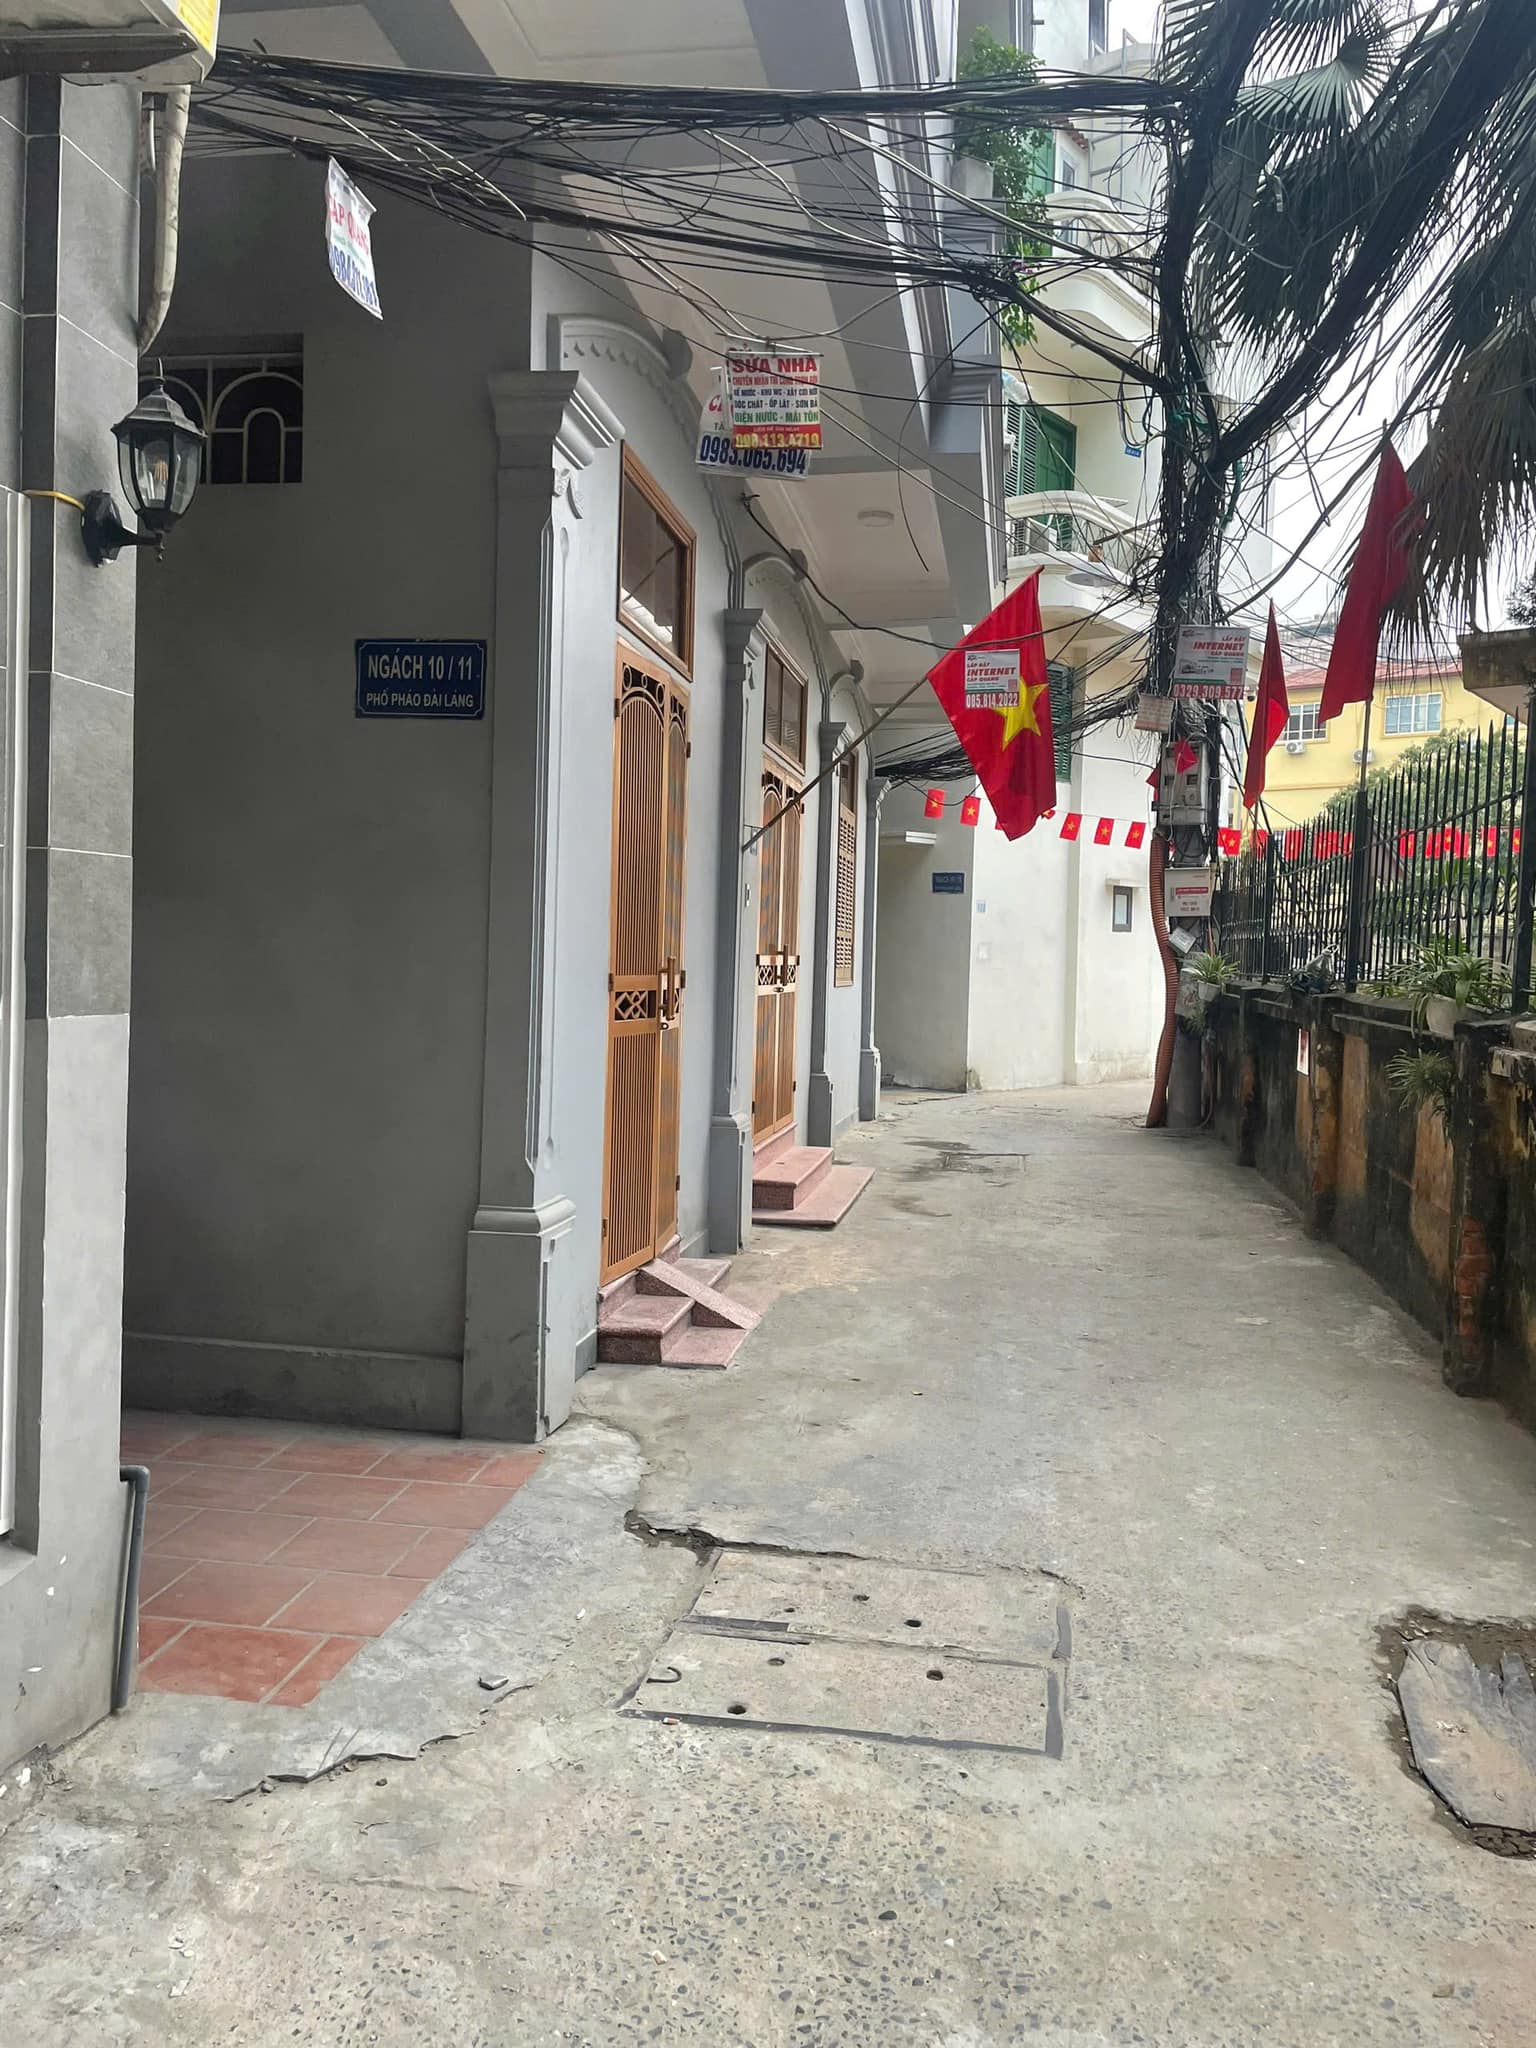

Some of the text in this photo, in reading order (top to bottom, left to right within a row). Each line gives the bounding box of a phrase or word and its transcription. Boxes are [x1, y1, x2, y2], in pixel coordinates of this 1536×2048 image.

[1193, 642, 1245, 651] INTERNET
[368, 647, 423, 679] NGÁCH
[428, 655, 444, 680] 10
[458, 655, 472, 680] 11
[967, 667, 1016, 676] INTERNET
[366, 687, 389, 706] PHỐ
[391, 688, 421, 707] PHÁO
[444, 688, 474, 708] LÁNG
